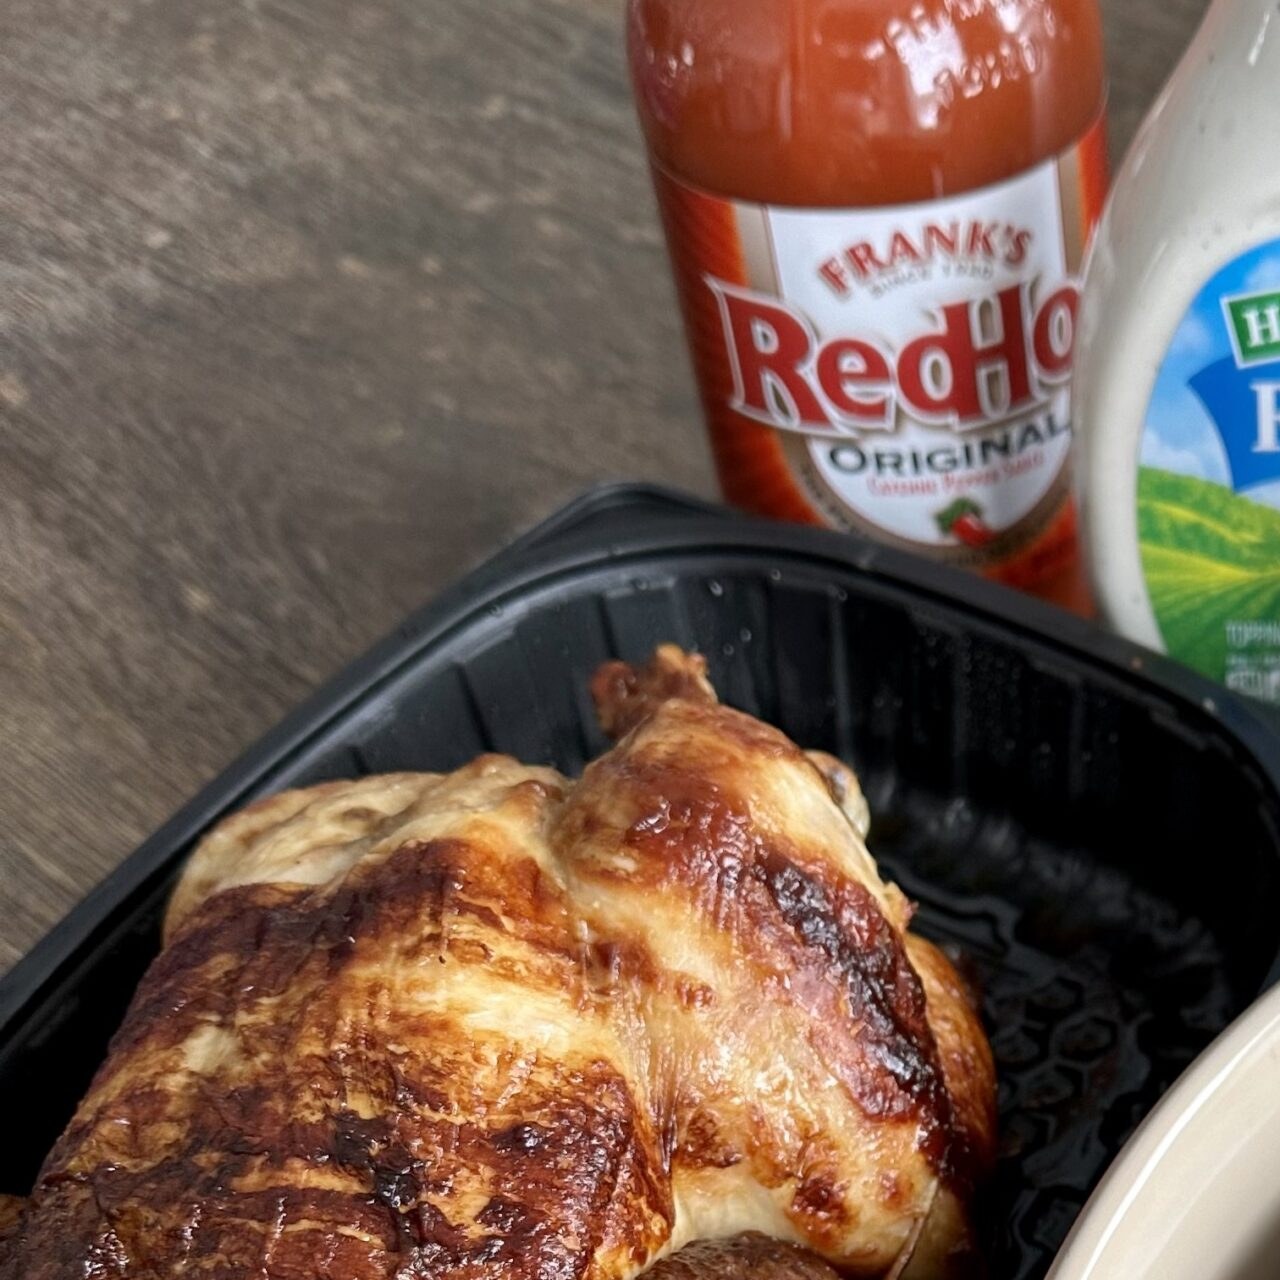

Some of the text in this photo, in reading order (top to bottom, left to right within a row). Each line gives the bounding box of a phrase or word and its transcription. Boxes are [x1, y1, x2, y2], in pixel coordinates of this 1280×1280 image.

[818, 221, 1032, 293] FRANK'S
[708, 280, 1082, 434] RedHo
[829, 415, 1072, 477] ORIGINAL
